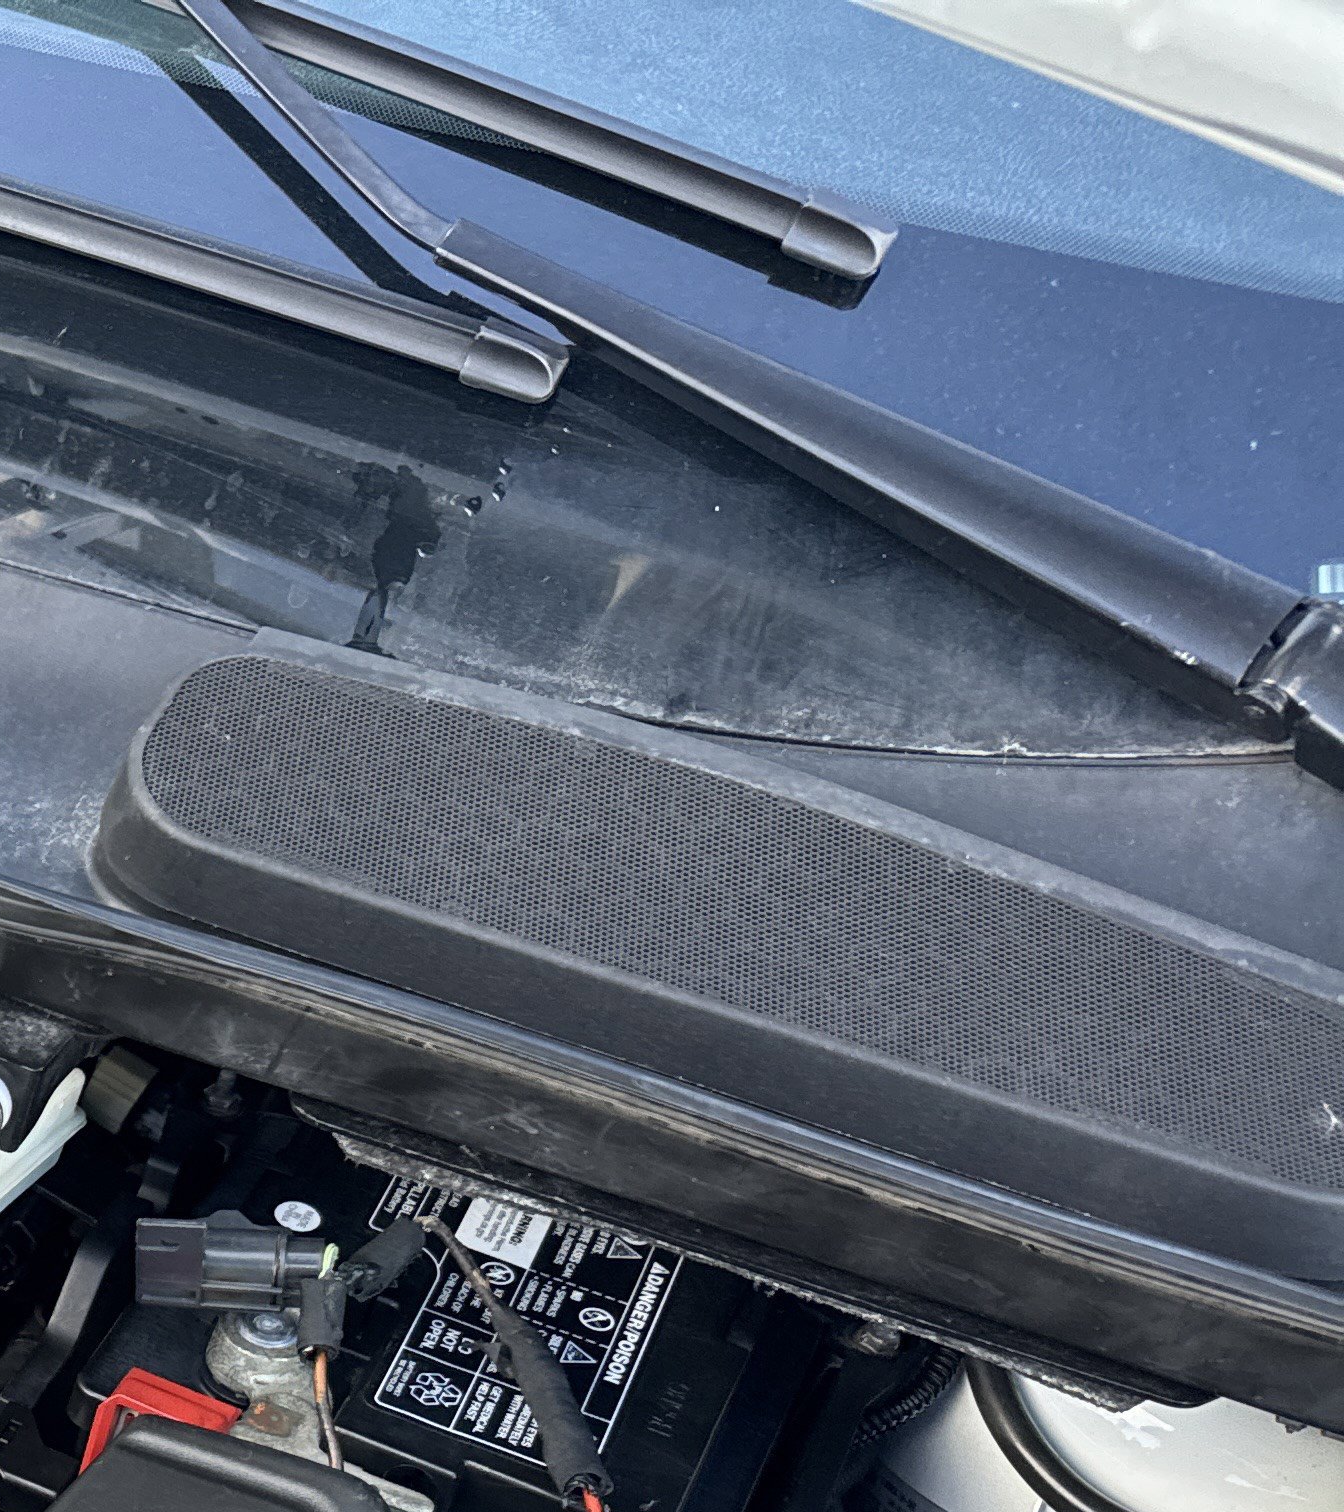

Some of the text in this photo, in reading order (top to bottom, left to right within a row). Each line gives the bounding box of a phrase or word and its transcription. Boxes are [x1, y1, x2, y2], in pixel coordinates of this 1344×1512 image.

[561, 1261, 576, 1279] CAN
[531, 1282, 553, 1313] FLAMES
[545, 1287, 566, 1318] SPARKS
[418, 1316, 446, 1353] OPEN.
[438, 1326, 461, 1353] NOT
[603, 1271, 665, 1384] DANGER/POISON
[463, 1379, 491, 1423] HELP FAST.
[487, 1384, 503, 1403] GET
[506, 1392, 524, 1414] WITH
[471, 1399, 496, 1436] MEDICAL
[506, 1402, 534, 1446] MEDIATELY
[519, 1425, 538, 1448] EYES
